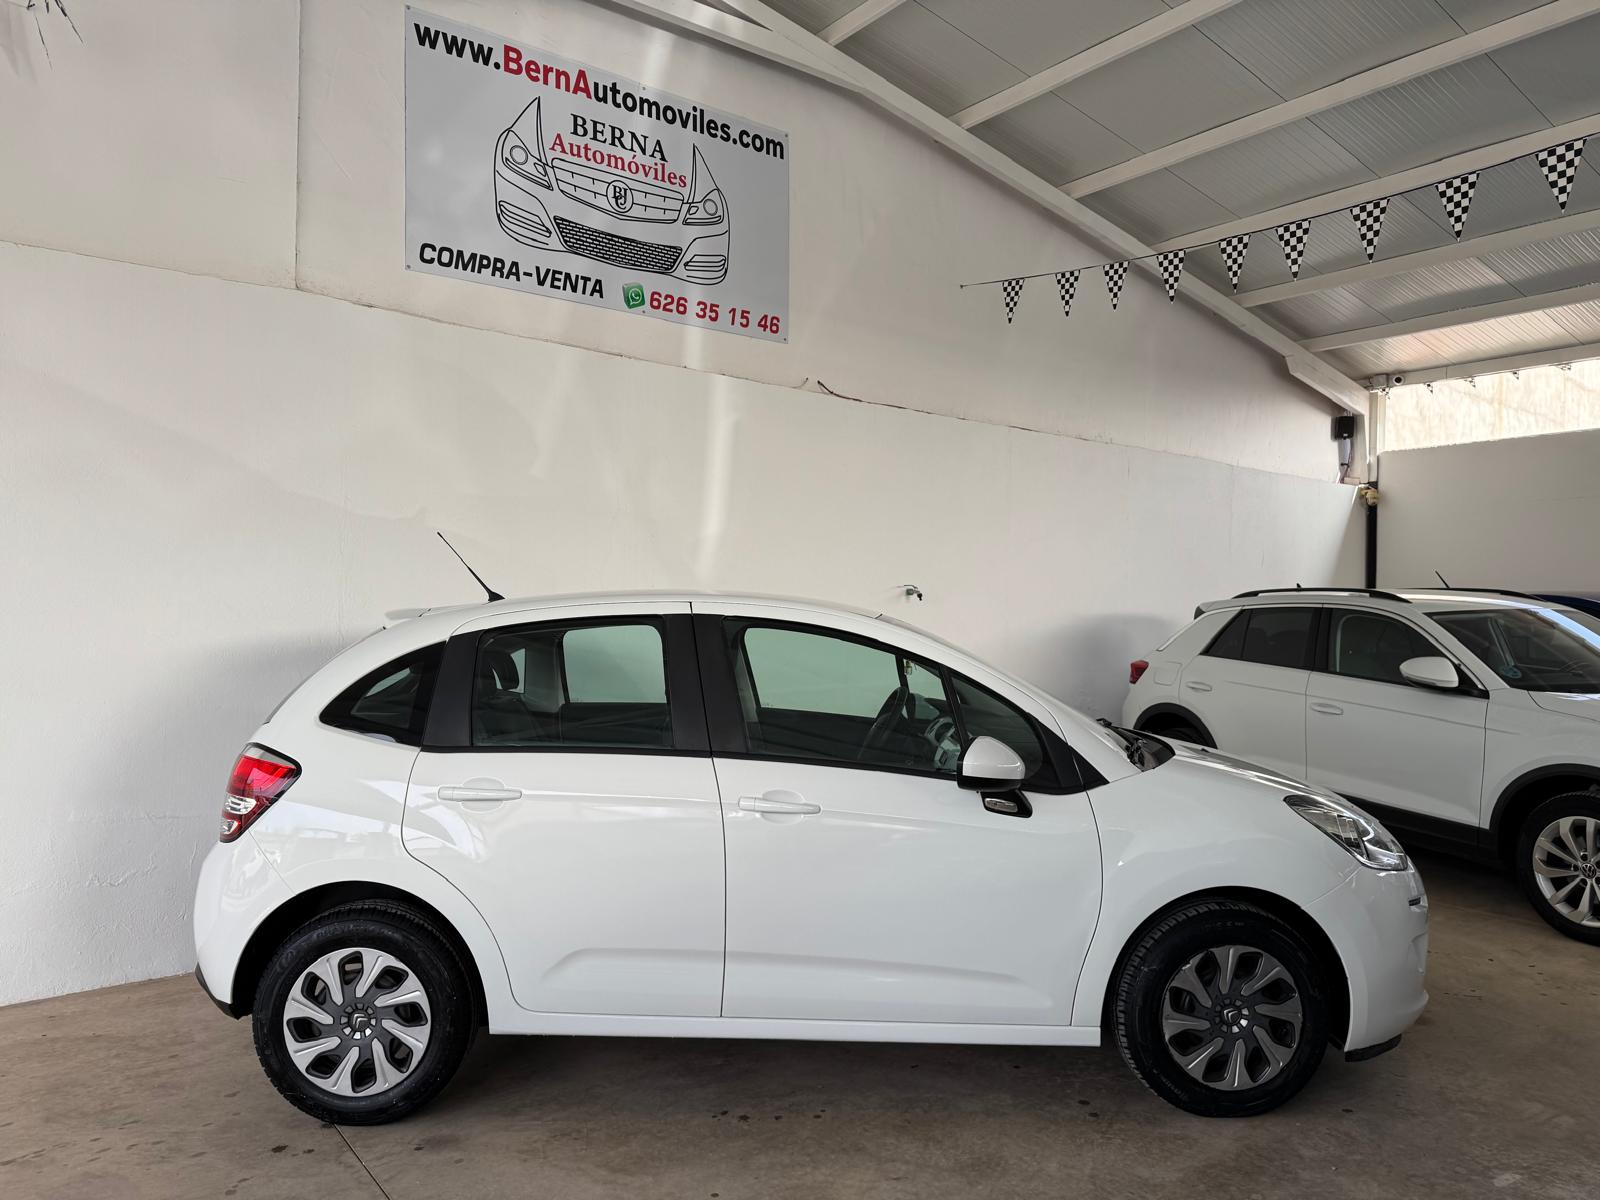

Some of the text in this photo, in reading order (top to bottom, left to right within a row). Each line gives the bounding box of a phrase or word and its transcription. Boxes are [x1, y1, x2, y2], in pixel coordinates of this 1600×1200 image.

[413, 22, 785, 160] www.BernAutomoviles.com
[549, 132, 688, 188] Automóviles
[570, 113, 668, 162] BERNA
[419, 243, 604, 299] COMPRA-VENTA
[649, 291, 781, 334] 626 35 15 46
